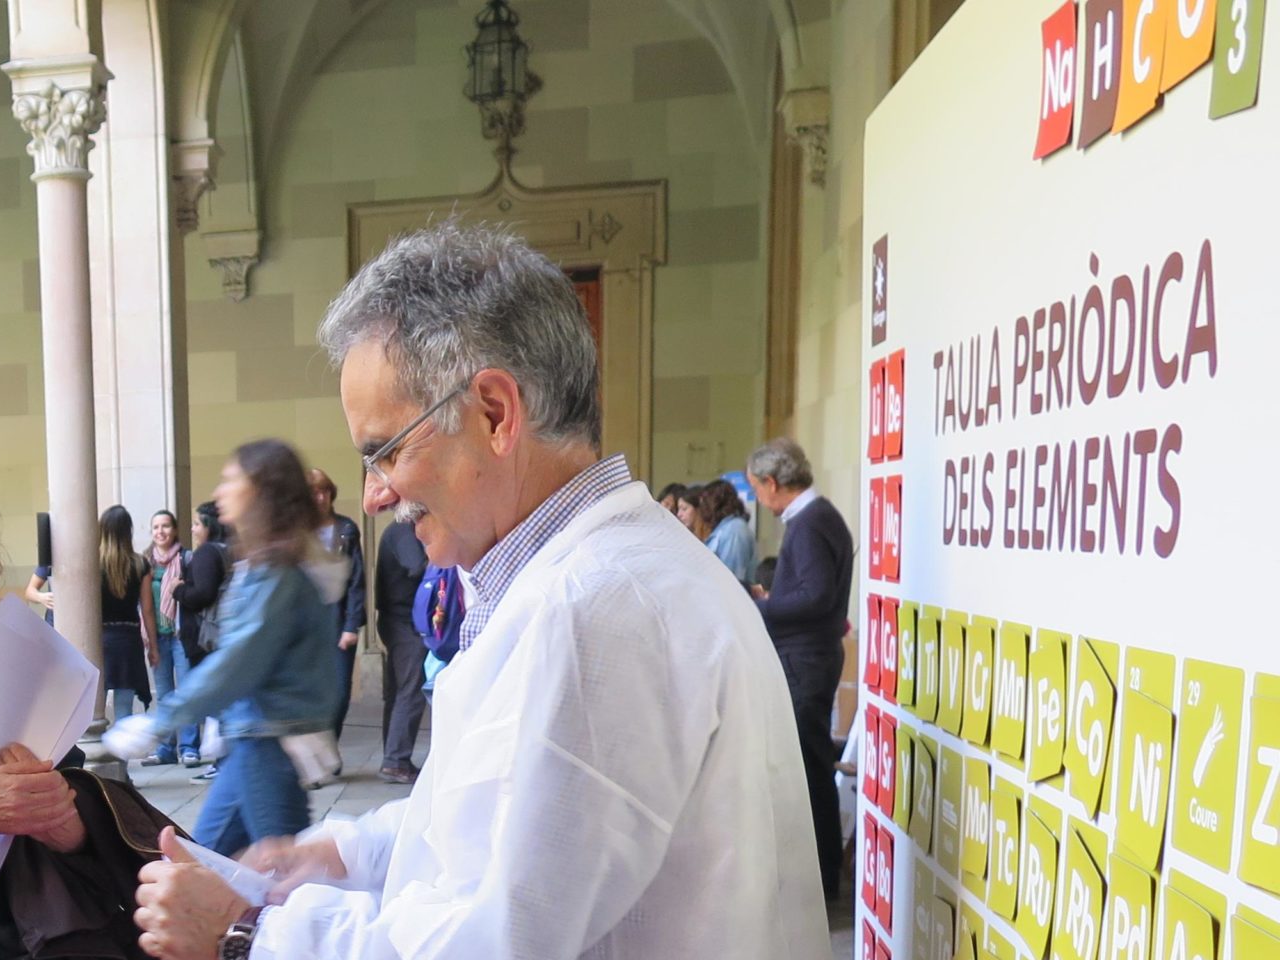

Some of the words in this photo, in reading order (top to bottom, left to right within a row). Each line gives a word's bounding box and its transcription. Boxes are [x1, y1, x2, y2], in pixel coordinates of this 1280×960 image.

[1042, 39, 1074, 120] Na
[1092, 9, 1114, 101] H
[1227, 0, 1248, 75] 3
[933, 325, 1002, 437] TAULA
[1012, 238, 1218, 420] PERIÒDICA
[887, 384, 901, 433] Be
[942, 451, 995, 549] DELS
[1003, 423, 1183, 559] ELEMENTS
[885, 502, 899, 557] Mg
[1129, 667, 1141, 691] 28
[1187, 680, 1201, 707] 29
[870, 619, 878, 665] K
[883, 621, 897, 672] Ca
[901, 629, 914, 681] Sc
[948, 646, 959, 710] V
[971, 651, 989, 712] Cr
[998, 658, 1024, 723] Mn
[1037, 677, 1060, 747] Fe
[1075, 680, 1104, 777] Co
[1129, 733, 1163, 828] Ni
[882, 741, 892, 791] Sr
[901, 750, 910, 811] Y
[965, 784, 988, 845] Mo
[996, 818, 1014, 886] Tc
[1025, 843, 1051, 927] Ru
[1189, 797, 1218, 832] Coure
[864, 839, 875, 887] Cs
[879, 851, 890, 902] Ba
